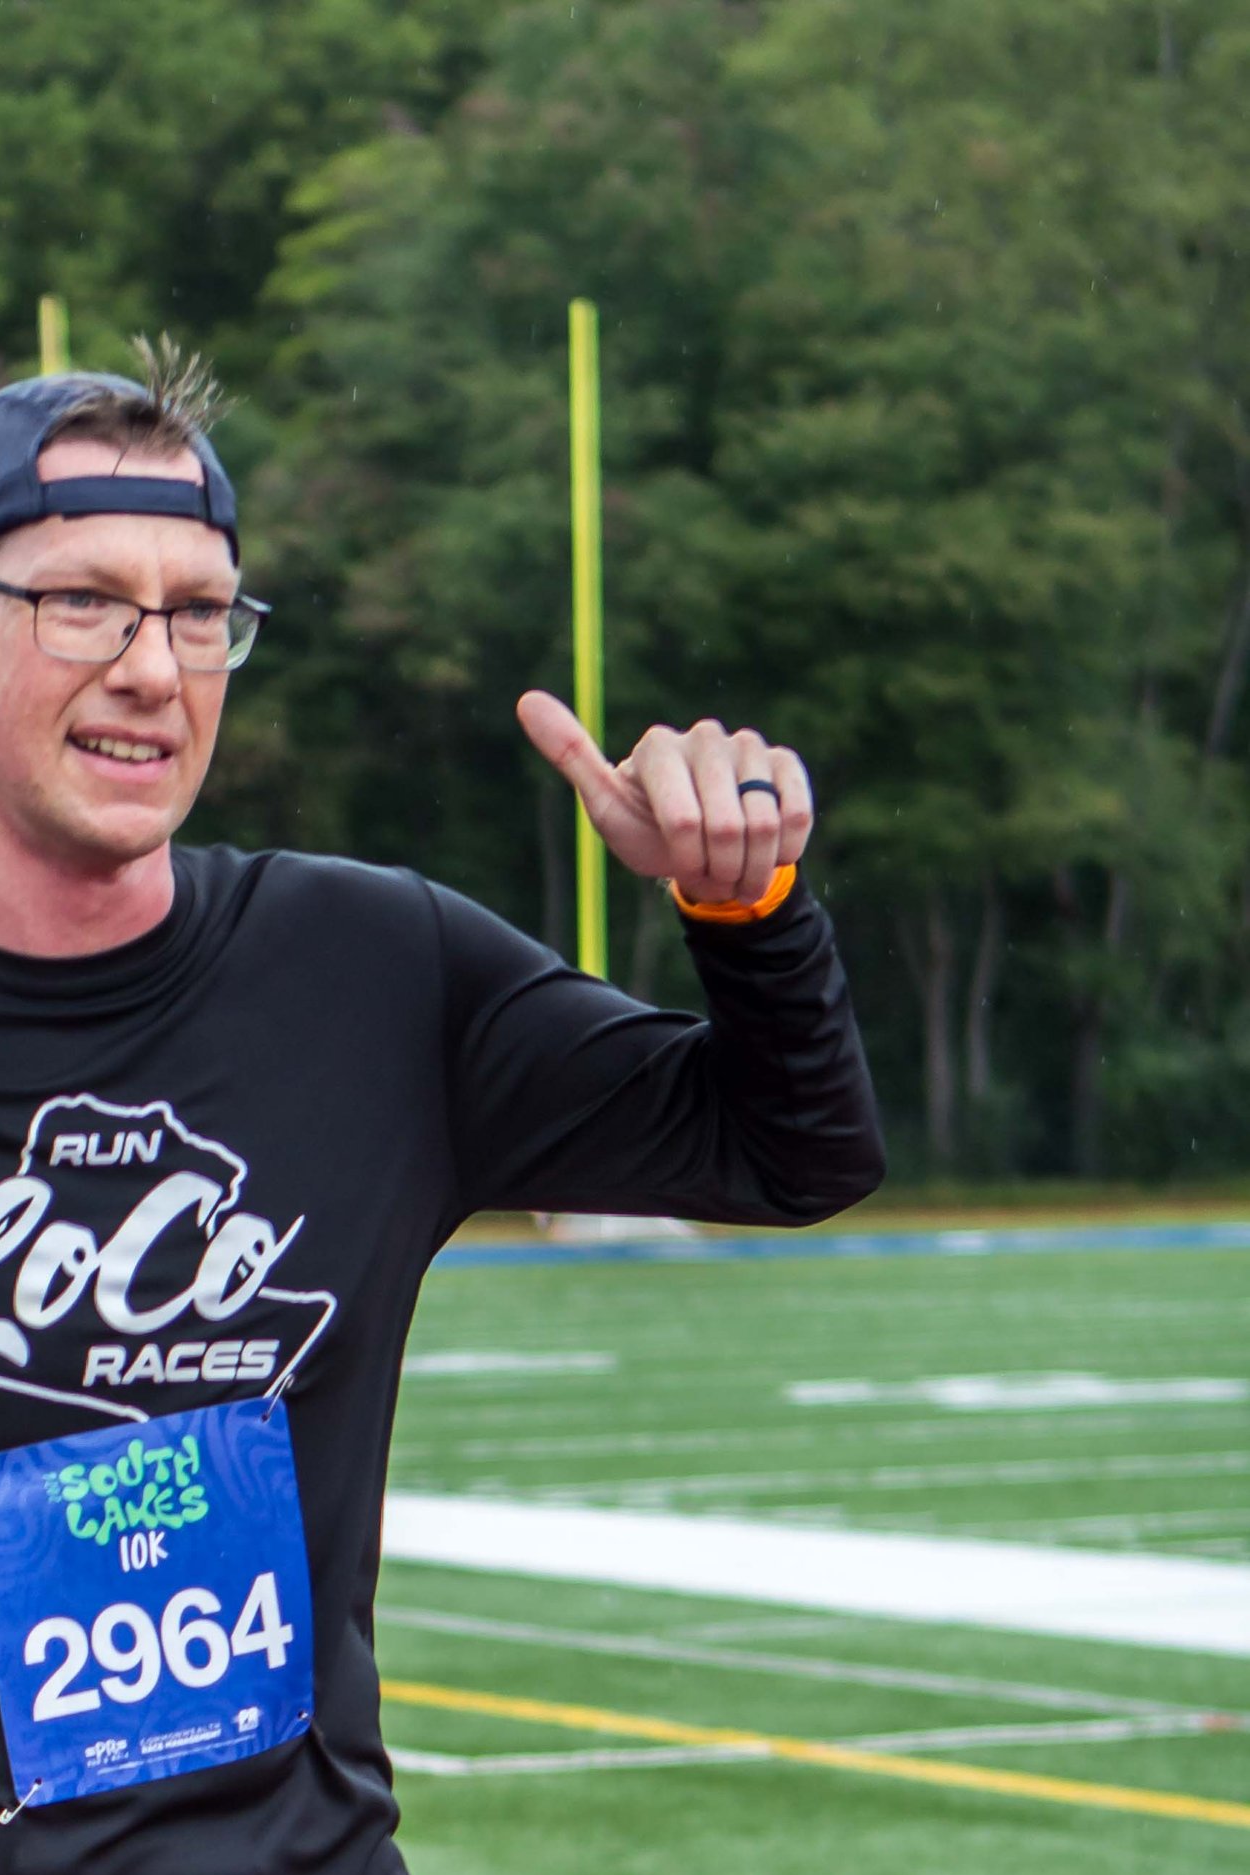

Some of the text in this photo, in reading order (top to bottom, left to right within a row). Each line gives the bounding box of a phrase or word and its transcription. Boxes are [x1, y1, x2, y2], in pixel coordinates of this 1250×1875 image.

[50, 1129, 163, 1166] RUN
[82, 1339, 280, 1387] RACES
[59, 1434, 200, 1501] SOUTH
[65, 1481, 210, 1546] LAKES
[120, 1530, 169, 1573] 10K
[23, 1571, 294, 1722] 2964
